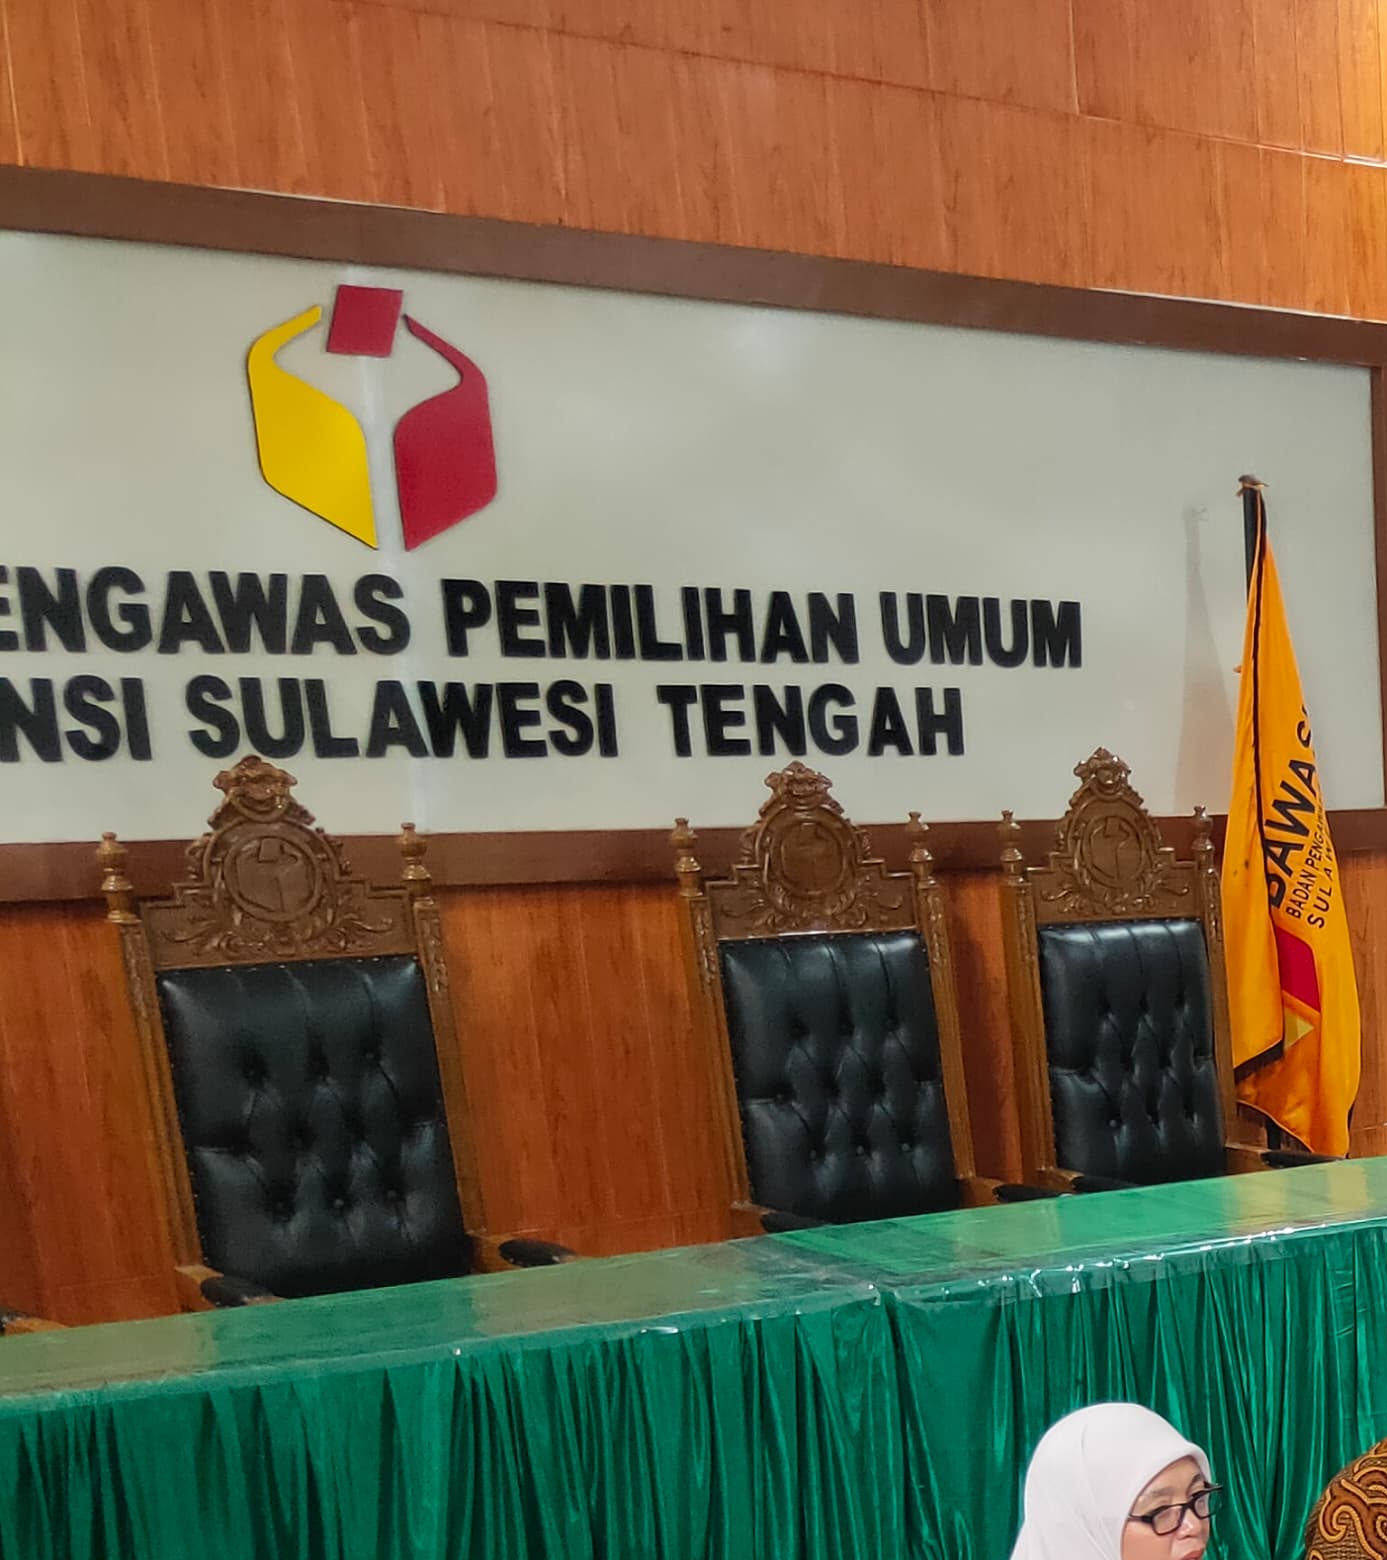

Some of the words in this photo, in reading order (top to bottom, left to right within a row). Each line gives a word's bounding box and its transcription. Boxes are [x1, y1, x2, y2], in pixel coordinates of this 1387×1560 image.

[440, 578, 860, 665] PEMILIHAN
[879, 591, 1082, 669] UMUM
[0, 674, 153, 763] NSI
[185, 674, 619, 760] SULAWESI
[655, 683, 965, 758] TENGAH
[1263, 704, 1318, 909] BAWAS
[1285, 869, 1317, 919] BADAN
